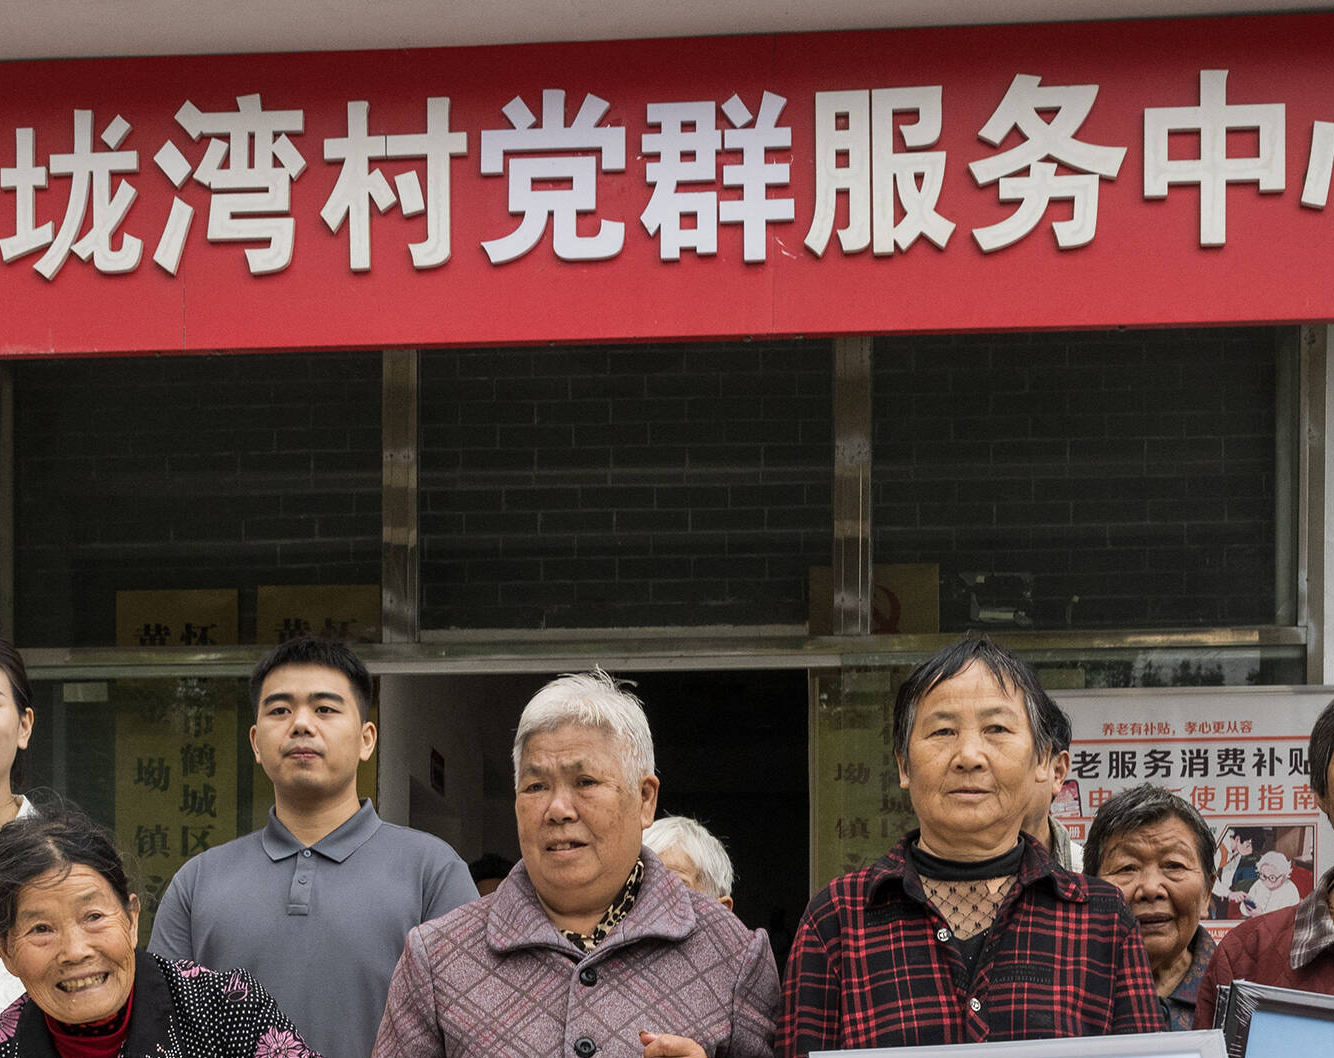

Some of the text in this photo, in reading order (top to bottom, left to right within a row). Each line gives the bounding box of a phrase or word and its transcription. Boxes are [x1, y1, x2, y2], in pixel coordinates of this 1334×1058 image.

[1088, 783, 1319, 812] 电使用指南
